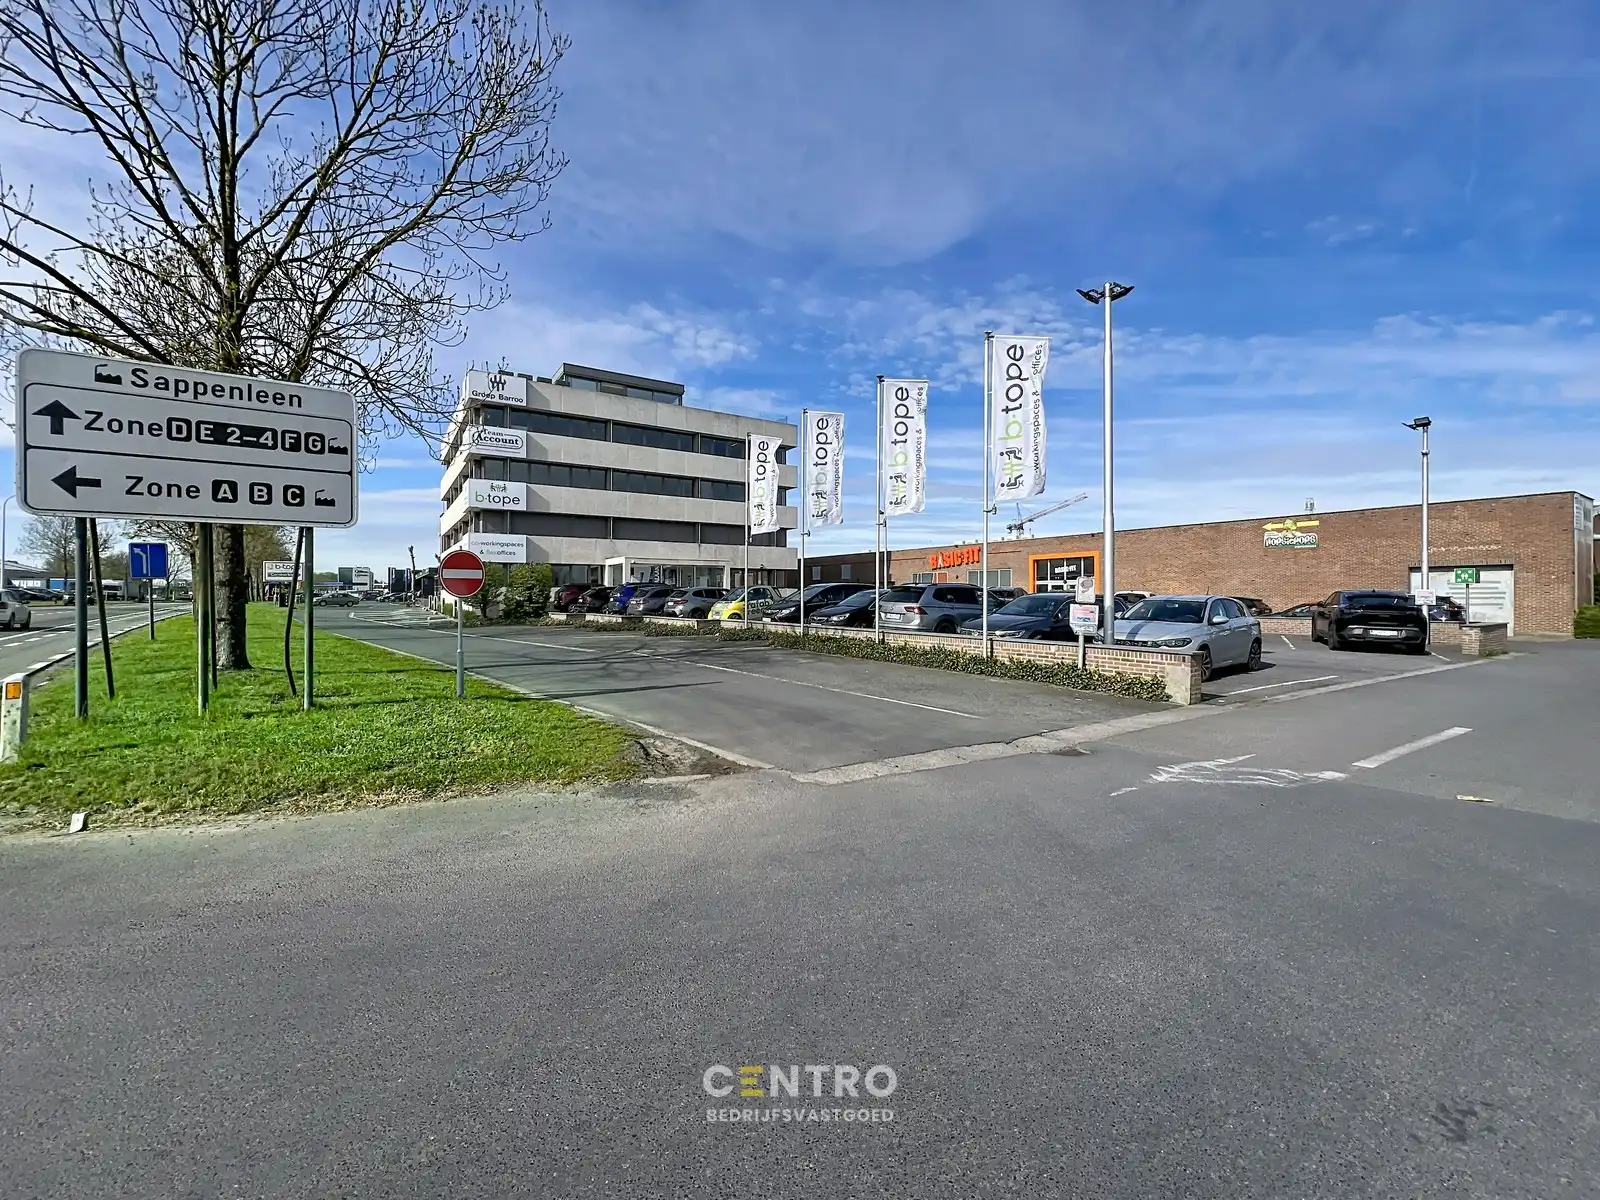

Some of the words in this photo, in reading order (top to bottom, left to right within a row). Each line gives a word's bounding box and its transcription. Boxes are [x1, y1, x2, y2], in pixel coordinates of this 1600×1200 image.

[1031, 343, 1043, 376] offices
[130, 367, 303, 408] Sappenleen
[471, 389, 496, 400] Groep
[498, 393, 524, 403] Barroo
[83, 409, 164, 438] Zone
[225, 426, 274, 448] 2-4
[474, 431, 520, 446] Account
[483, 428, 504, 437] Team
[124, 475, 201, 500] Zone
